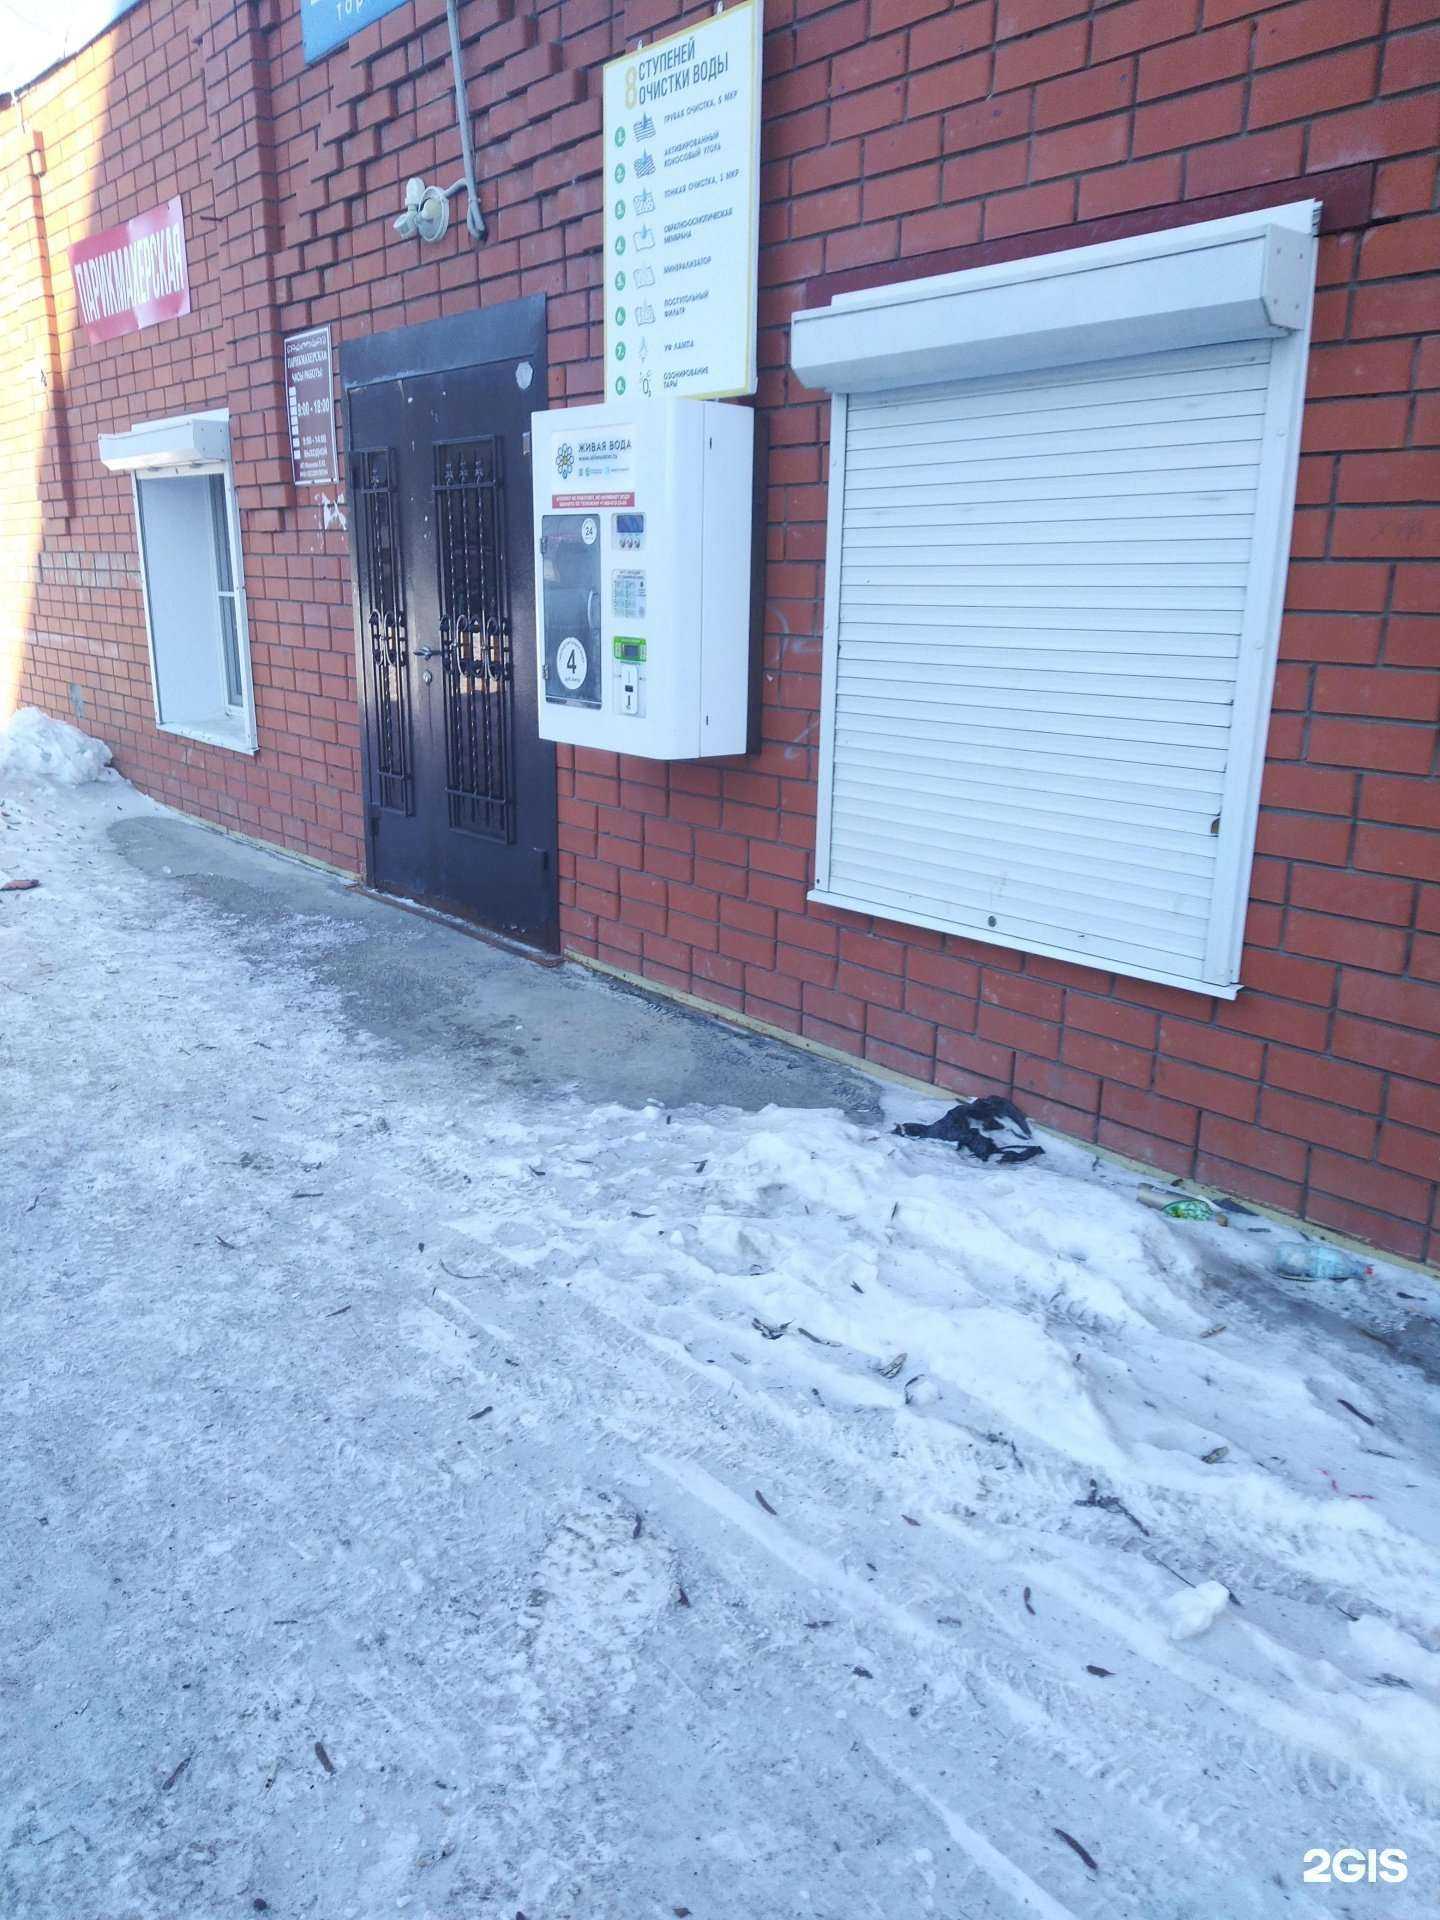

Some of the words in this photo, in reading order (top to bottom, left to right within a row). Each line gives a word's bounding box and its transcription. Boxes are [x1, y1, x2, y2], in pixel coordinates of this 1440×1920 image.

[638, 36, 695, 81] СТУПЕНЕЙ
[639, 69, 689, 105] ОЧИСТКИ
[693, 52, 728, 84] ВОДЫ
[74, 222, 185, 325] ПАРИКМАХЕРСКАЯ
[579, 441, 606, 453] ЖИВАЯ
[609, 440, 632, 451] ВОДА
[567, 649, 577, 674] 4
